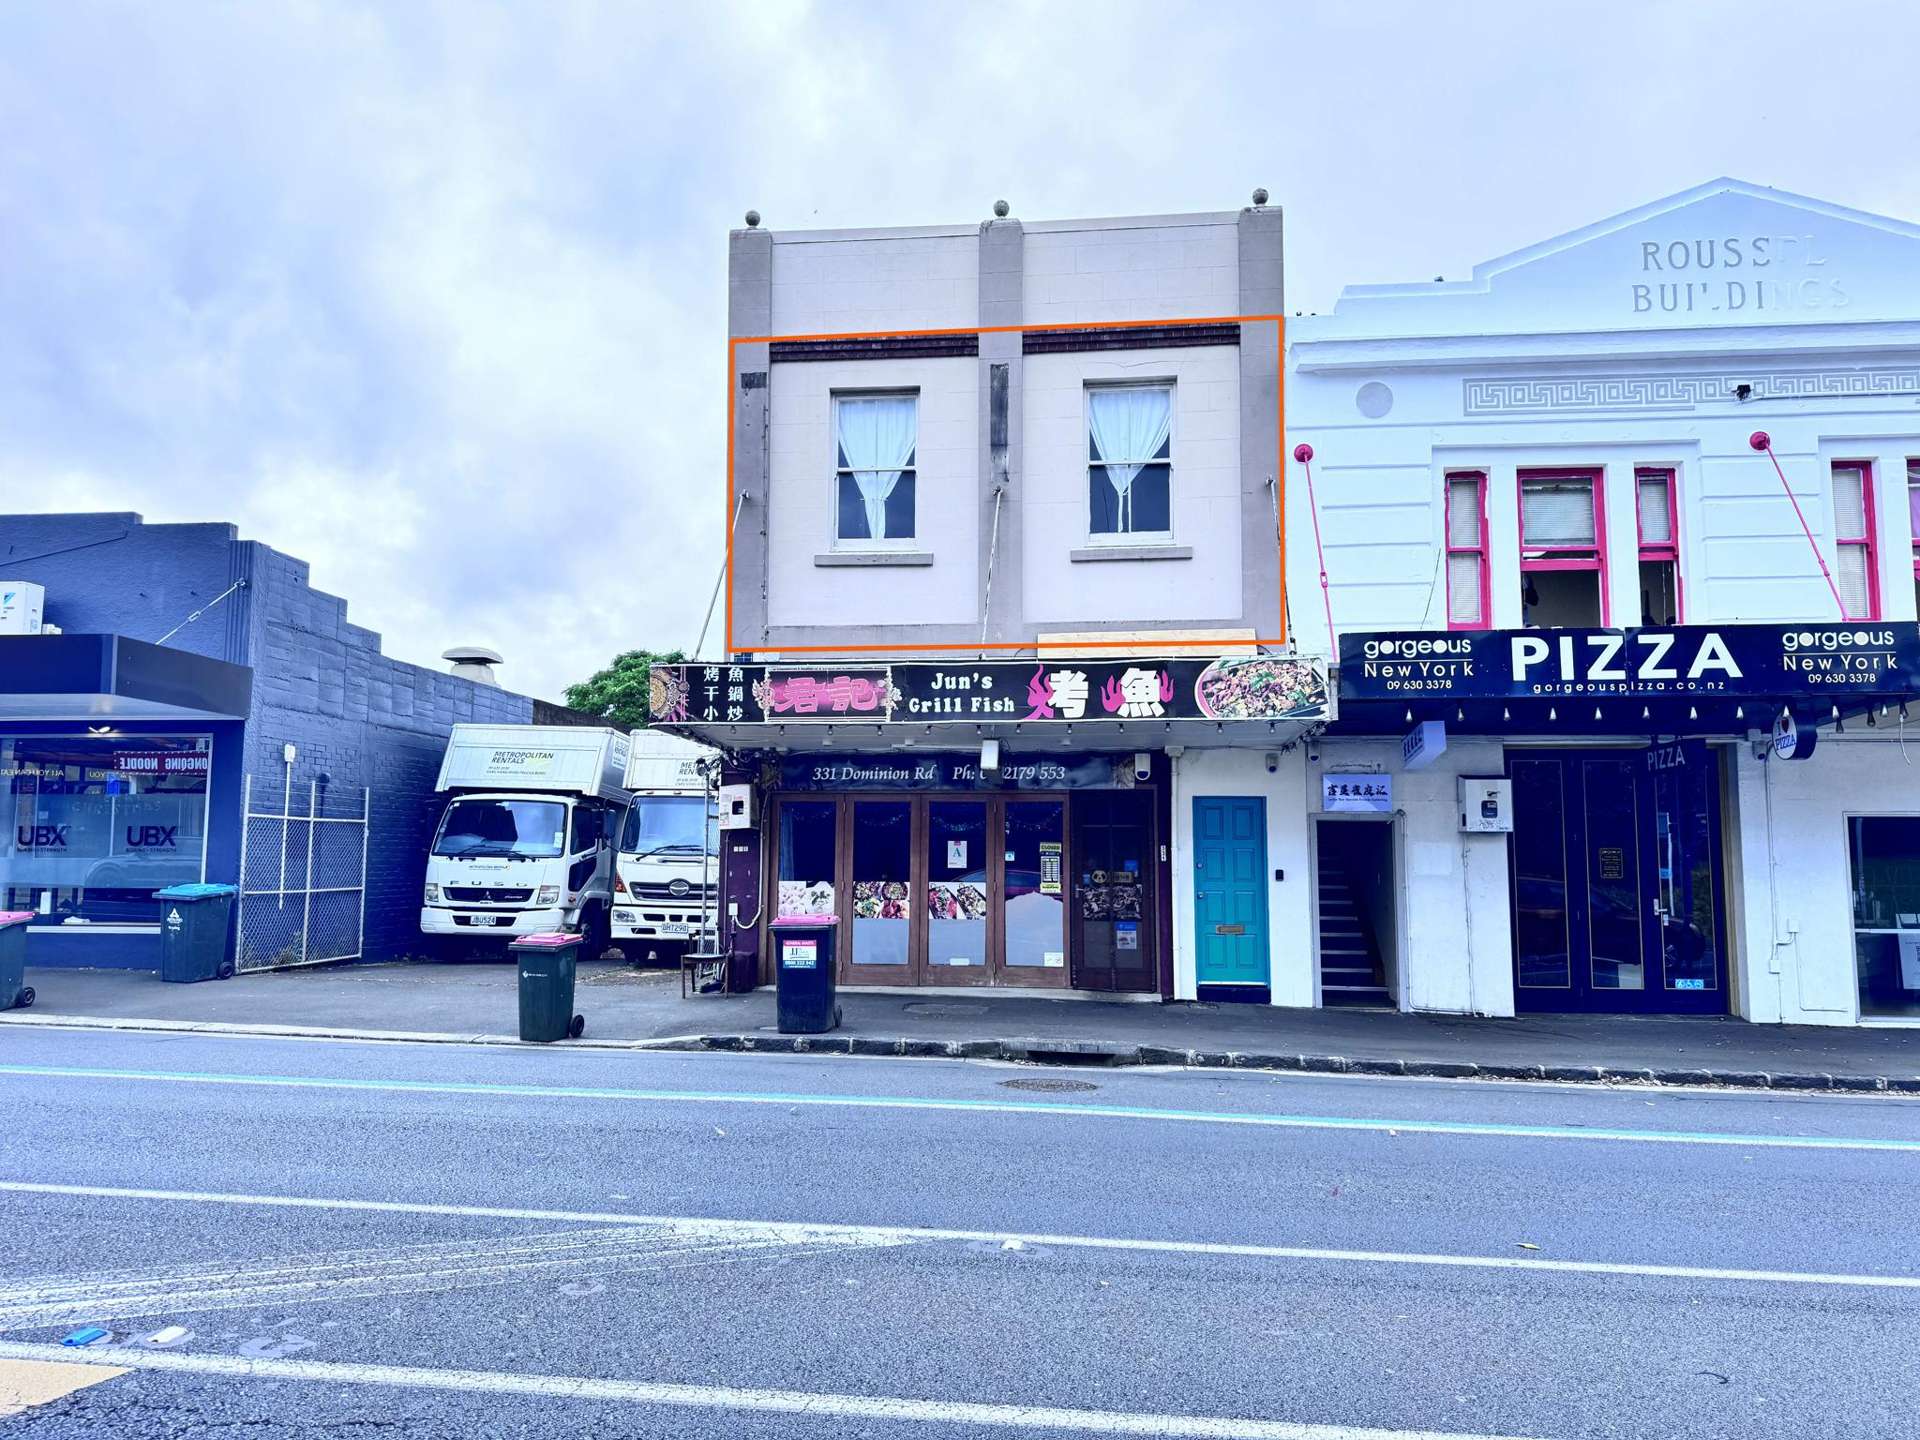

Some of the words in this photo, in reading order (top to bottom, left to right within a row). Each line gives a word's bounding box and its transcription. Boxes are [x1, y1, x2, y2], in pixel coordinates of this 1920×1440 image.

[1364, 639, 1472, 659] gorgeous
[1782, 631, 1895, 651] gorgeous
[1511, 633, 1744, 681] PIZZA
[1783, 655, 1833, 671] New
[1840, 654, 1898, 670] York
[1364, 663, 1412, 678] New
[1419, 662, 1474, 677] York
[931, 672, 993, 690] Jun's
[1387, 681, 1401, 690] 09
[1403, 680, 1423, 690] 630
[1426, 680, 1452, 689] 3378
[1808, 674, 1822, 684] 09
[1825, 674, 1846, 683] 630
[1849, 673, 1876, 683] 3378
[1533, 682, 1725, 694] gorgeouspizza.co.nz
[703, 705, 744, 721] 小炒
[909, 697, 962, 713] Grill
[971, 697, 1015, 713] Fish
[1775, 734, 1796, 750] PIZZA
[494, 751, 554, 760] METROPOLITAN
[1647, 745, 1686, 771] PIZZA
[812, 767, 836, 780] 331
[841, 766, 910, 780] Dominion
[913, 764, 937, 780] Rd
[952, 765, 975, 780] Ph:
[1039, 766, 1066, 780] 553
[18, 826, 67, 846] UBX
[127, 825, 176, 846] UBX
